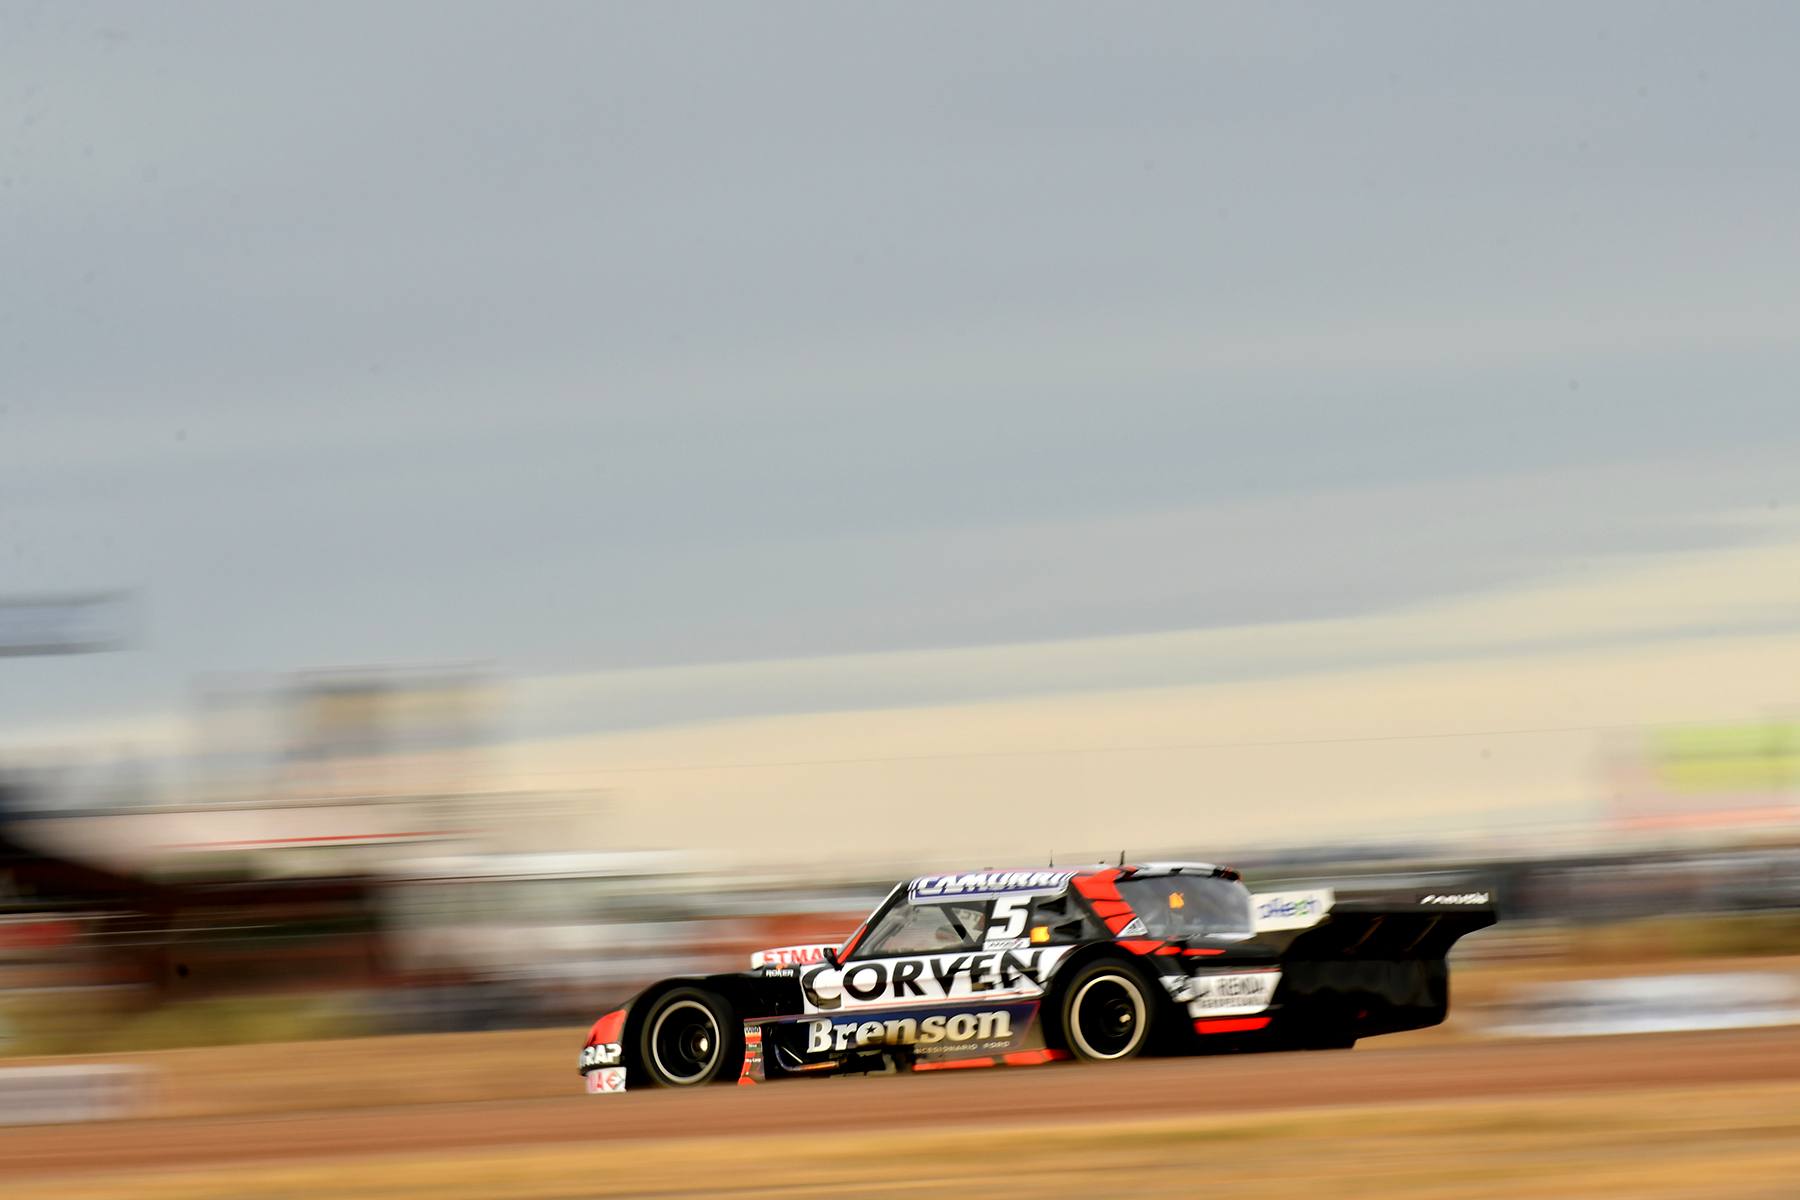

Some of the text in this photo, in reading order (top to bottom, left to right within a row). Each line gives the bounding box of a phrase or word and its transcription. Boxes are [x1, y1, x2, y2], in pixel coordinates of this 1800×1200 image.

[986, 895, 1033, 939] 5
[763, 946, 838, 966] ETMA
[801, 948, 1047, 1010] CORVEN
[806, 1010, 1014, 1054] Brenson
